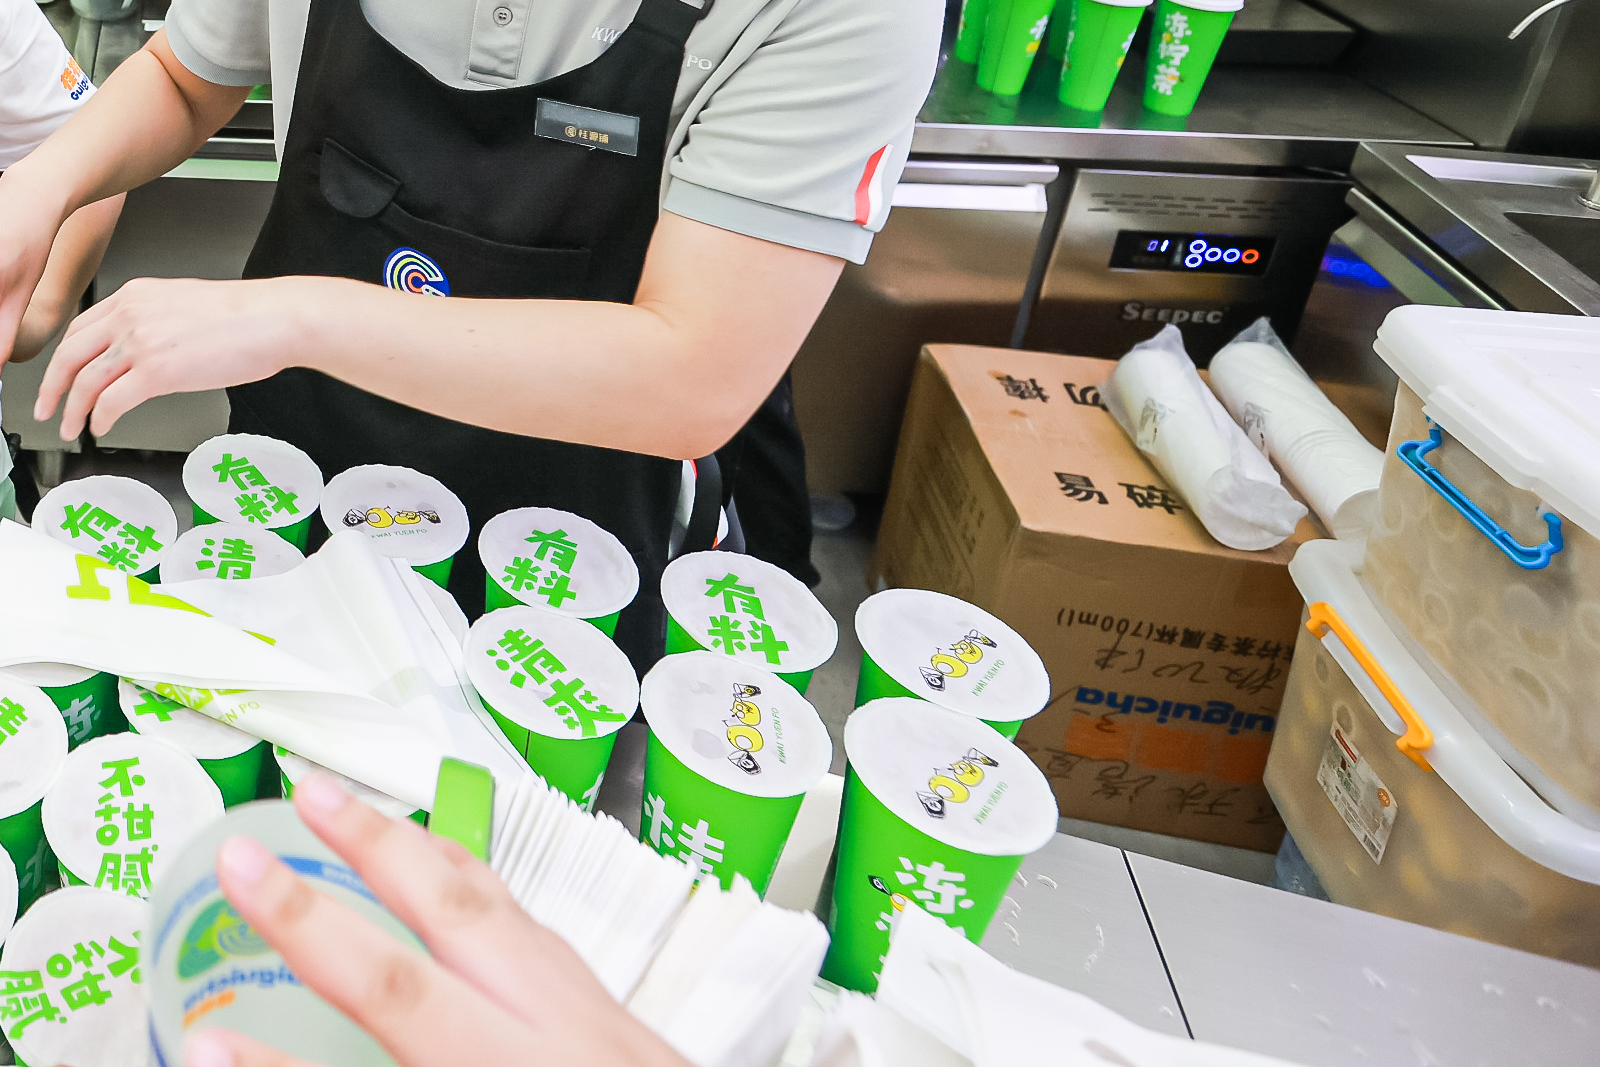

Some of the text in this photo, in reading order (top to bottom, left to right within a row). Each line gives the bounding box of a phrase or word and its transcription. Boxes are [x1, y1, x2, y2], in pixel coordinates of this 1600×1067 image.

[686, 54, 712, 70] PO
[1152, 11, 1192, 96] 冻柠茶
[212, 453, 301, 524] 有料
[59, 502, 164, 572] 有料
[501, 528, 578, 609] 有料
[705, 572, 790, 665] 有料
[1074, 686, 1276, 735] uiguicha
[899, 856, 975, 915] 冻
